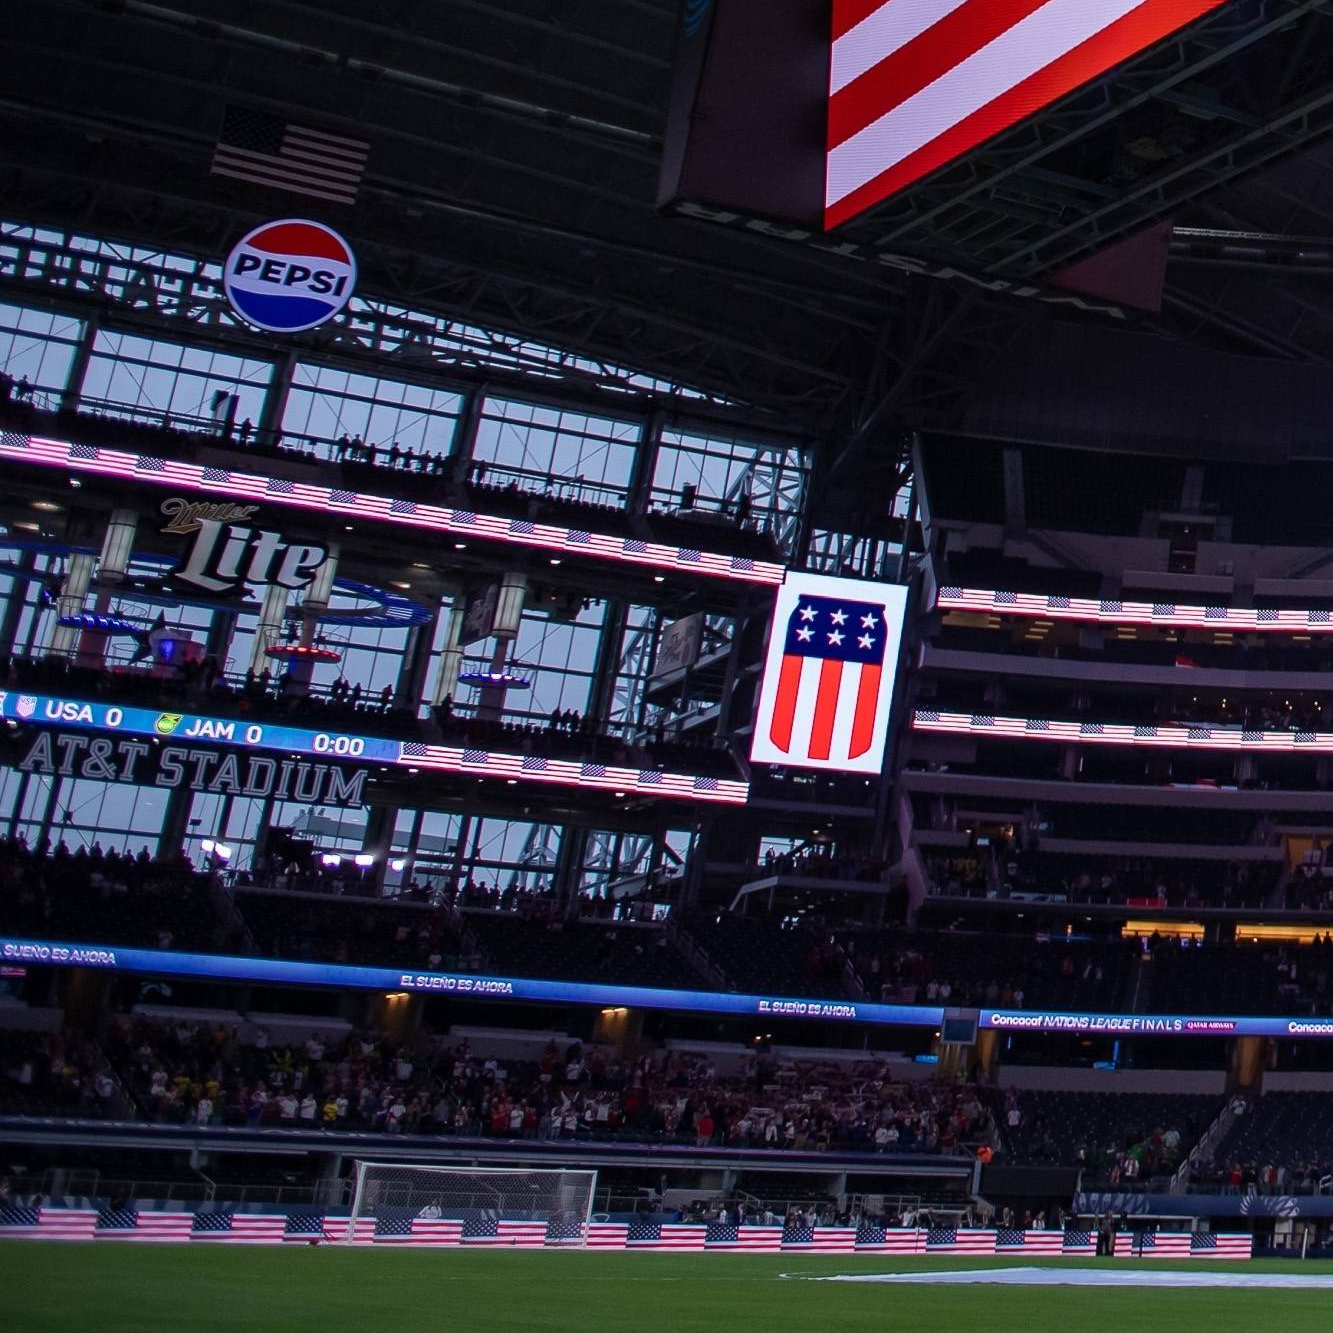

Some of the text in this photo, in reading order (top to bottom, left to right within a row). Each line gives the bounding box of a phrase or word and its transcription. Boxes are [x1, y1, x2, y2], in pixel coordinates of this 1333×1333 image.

[232, 253, 348, 298] PEPSI
[160, 498, 260, 534] Miller
[174, 517, 326, 591] Lite
[46, 700, 365, 756] USA 0 JAM 0 0:00
[20, 732, 368, 808] AT&T STADIUM
[51, 948, 69, 960] ES
[70, 949, 116, 963] AHORA
[400, 974, 415, 986] EL
[457, 979, 472, 991] ES
[473, 980, 513, 993] AHORA
[759, 1000, 772, 1012] EL
[808, 1004, 821, 1015] ES
[991, 1013, 1042, 1027] Concacaf
[1043, 1016, 1089, 1029] NATIONS
[1090, 1017, 1133, 1030] LEAGUE
[1133, 1019, 1182, 1030] FINALS
